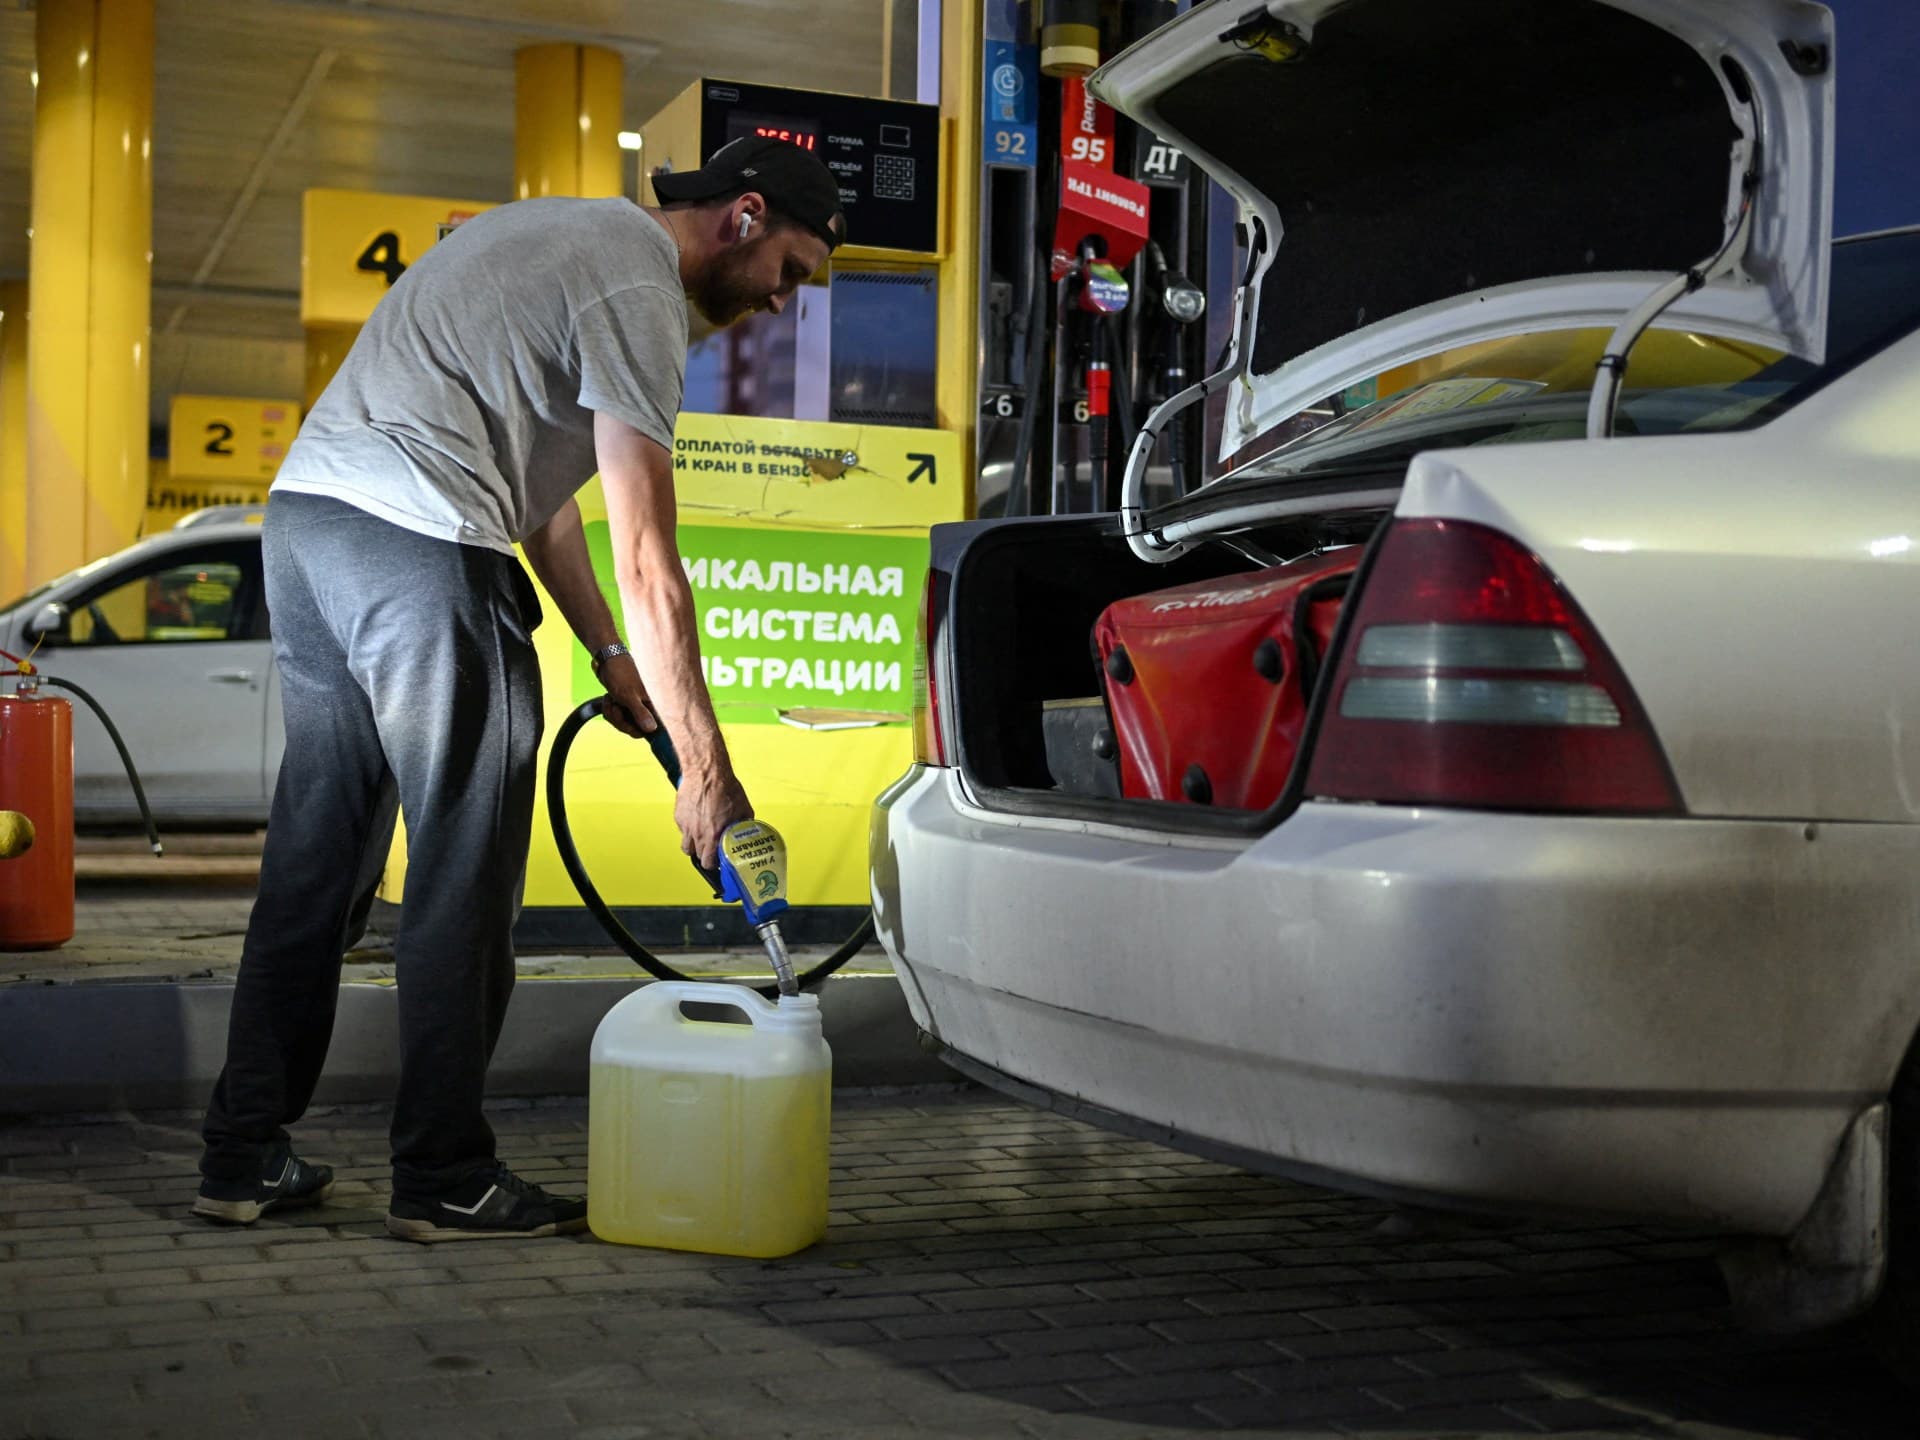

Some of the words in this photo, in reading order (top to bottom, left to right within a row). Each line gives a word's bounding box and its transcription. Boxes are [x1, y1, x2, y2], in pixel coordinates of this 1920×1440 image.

[827, 135, 864, 147] СУММА
[995, 131, 1026, 155] 92
[1071, 136, 1106, 163] 95
[1143, 145, 1184, 174] ДТ
[1066, 176, 1093, 199] ТРК
[357, 231, 407, 286] 4
[996, 395, 1013, 417] 6
[1074, 401, 1089, 423] 6
[205, 422, 235, 456] 2
[676, 439, 756, 456] ОПЛАТОЙ
[671, 454, 687, 470] Й
[692, 459, 737, 473] КРАН
[742, 462, 753, 474] В
[704, 607, 901, 645] СИСТЕМА
[749, 858, 768, 870] НАС
